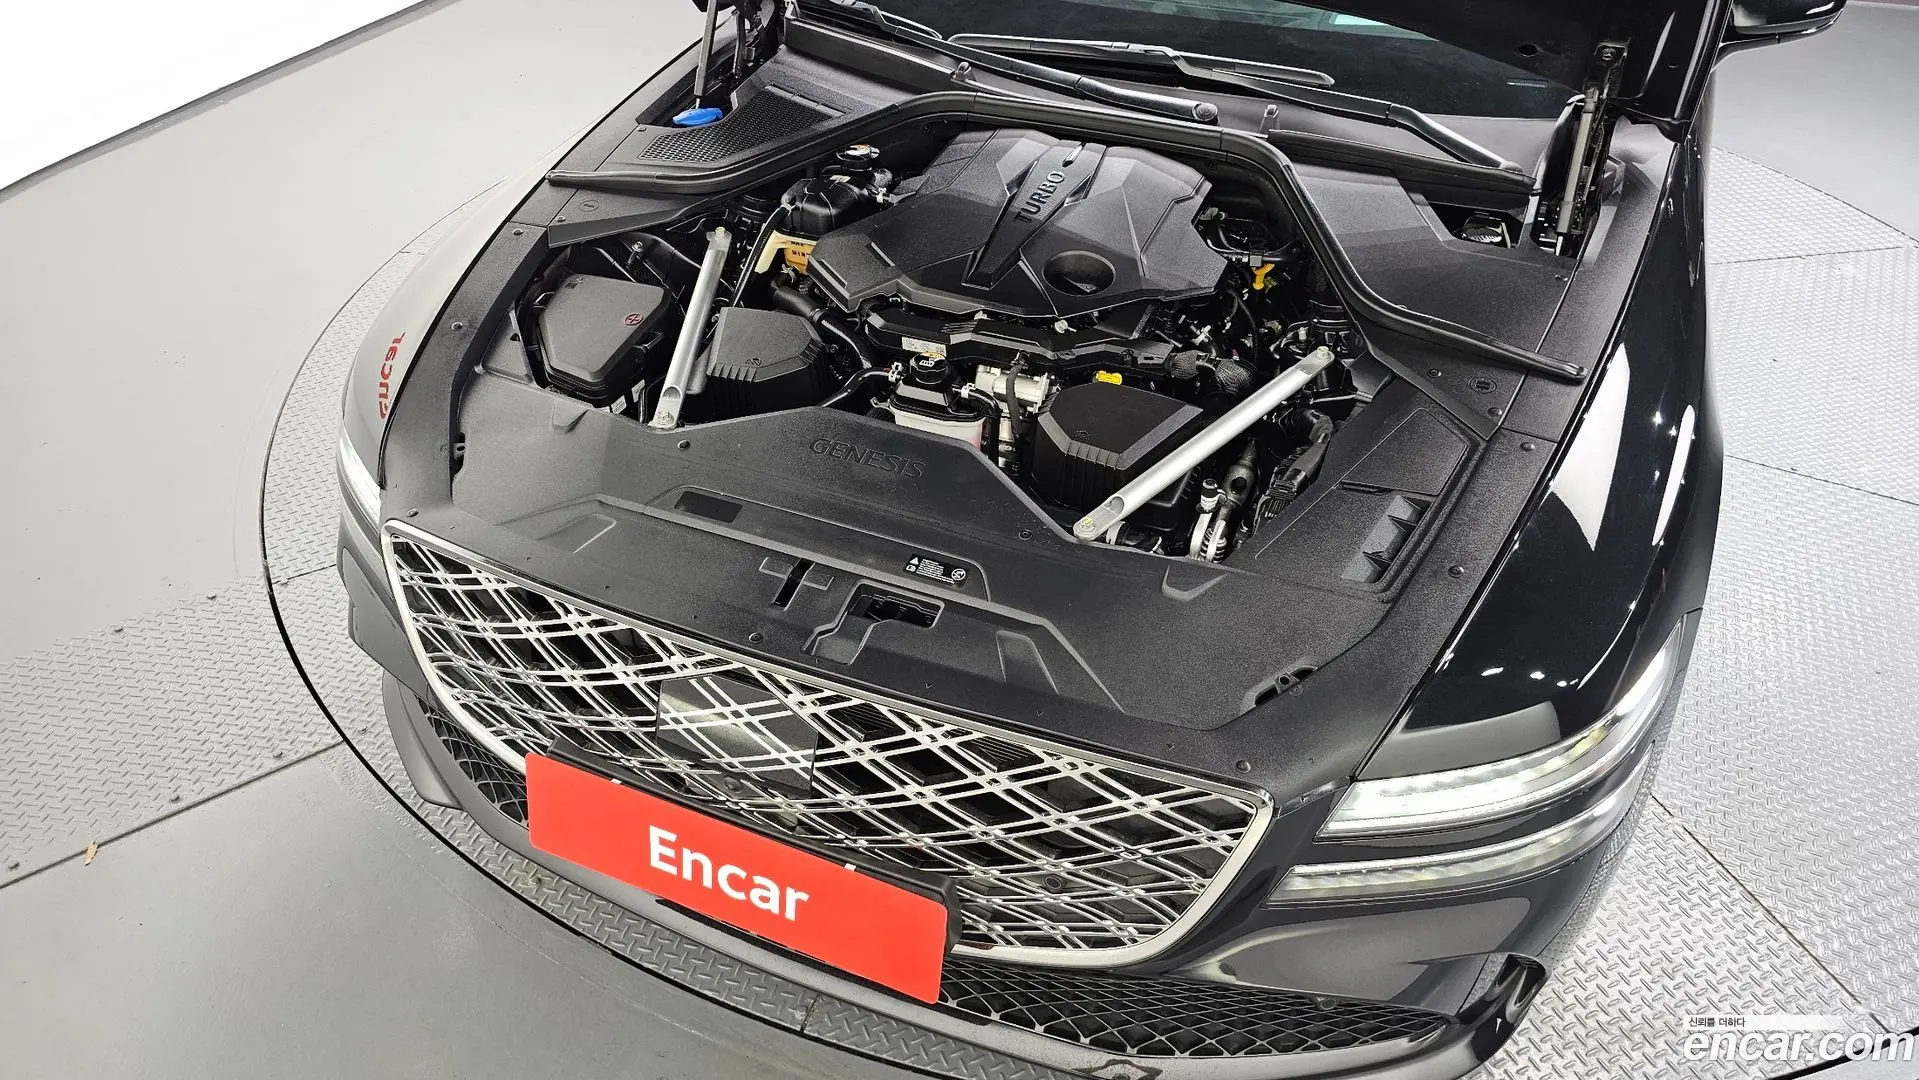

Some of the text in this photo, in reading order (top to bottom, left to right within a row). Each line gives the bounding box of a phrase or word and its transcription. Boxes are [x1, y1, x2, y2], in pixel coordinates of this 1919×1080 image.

[1013, 170, 1065, 223] TURBO
[809, 437, 926, 479] GENESIS
[648, 825, 809, 922] Encar
